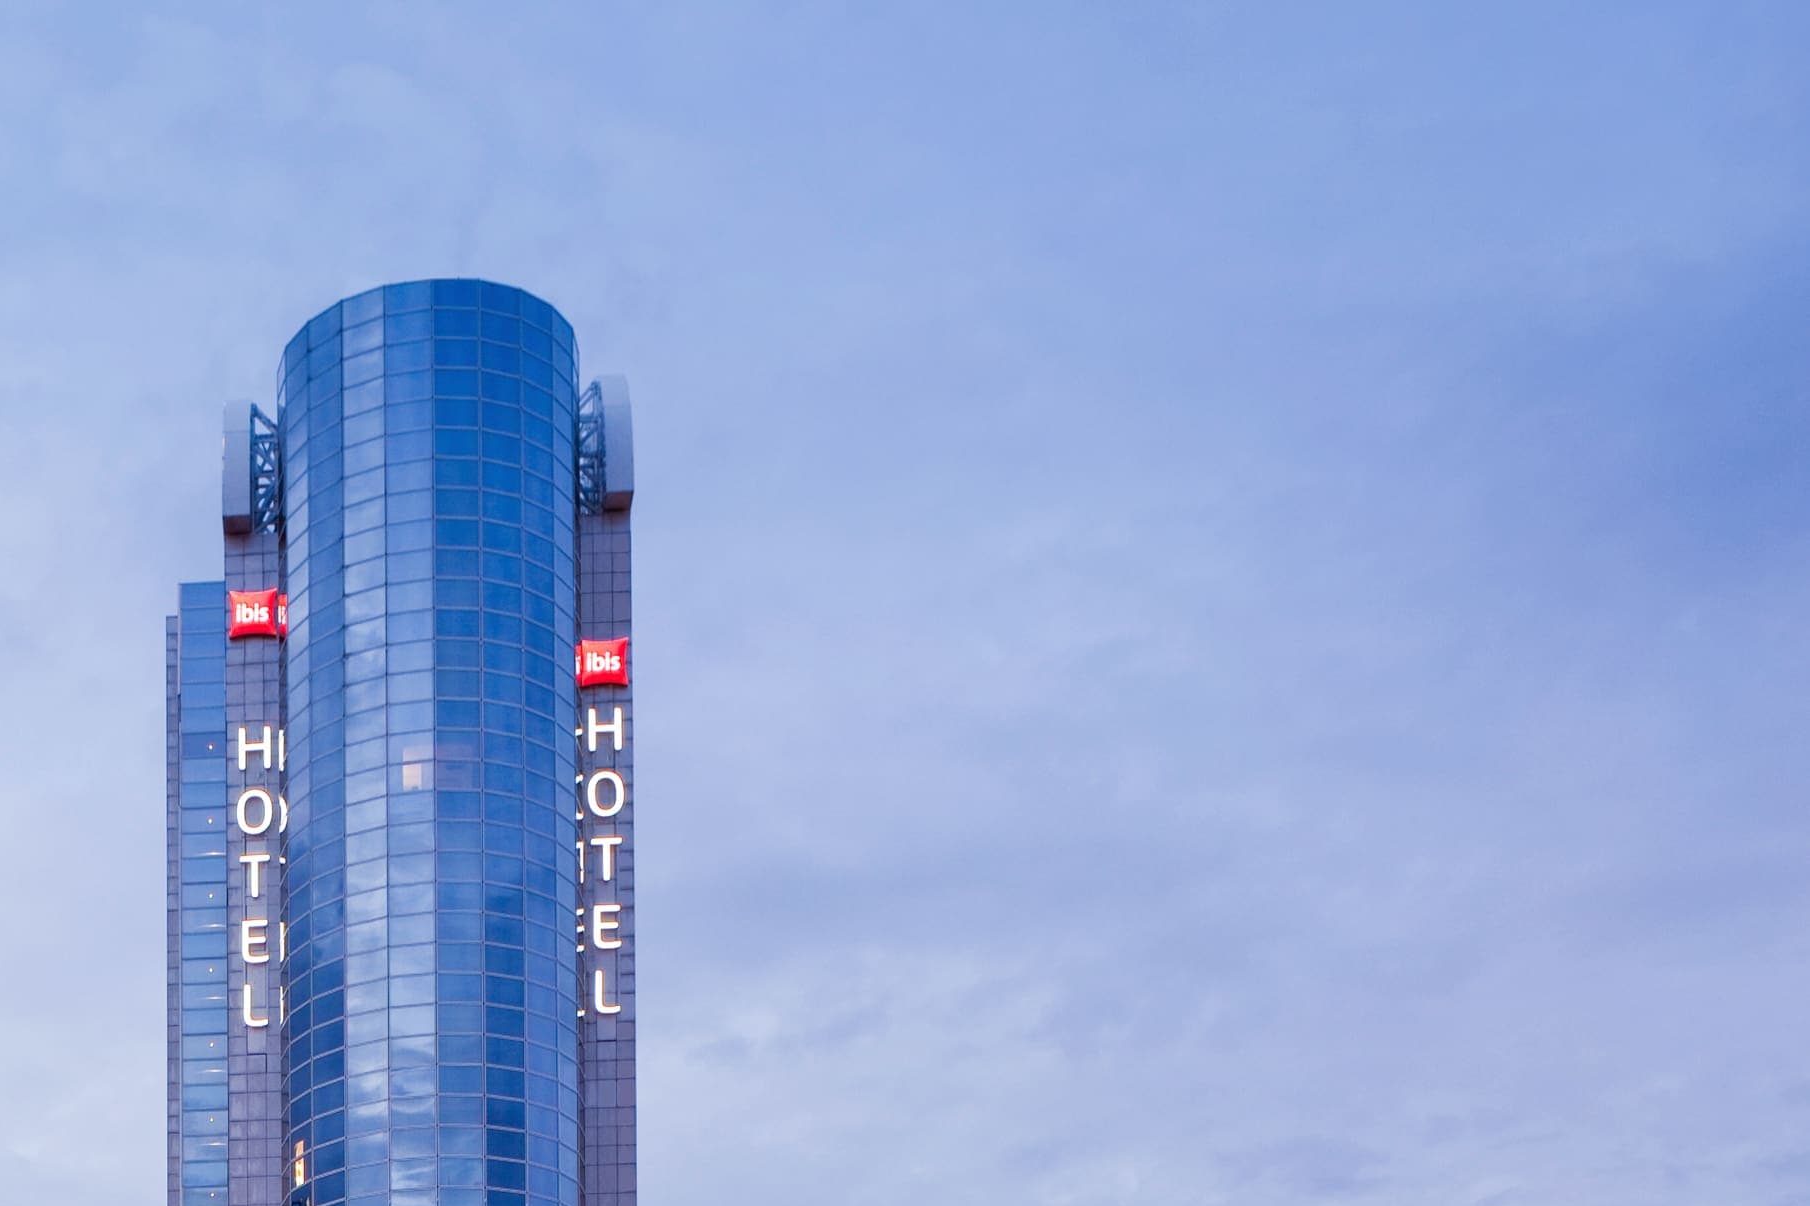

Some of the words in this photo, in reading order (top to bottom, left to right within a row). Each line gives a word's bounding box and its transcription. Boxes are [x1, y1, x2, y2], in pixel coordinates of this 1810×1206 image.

[235, 602, 270, 624] ibis
[586, 651, 621, 673] ibis
[236, 725, 273, 1028] HOTEL
[585, 706, 625, 1015] HOTEL
